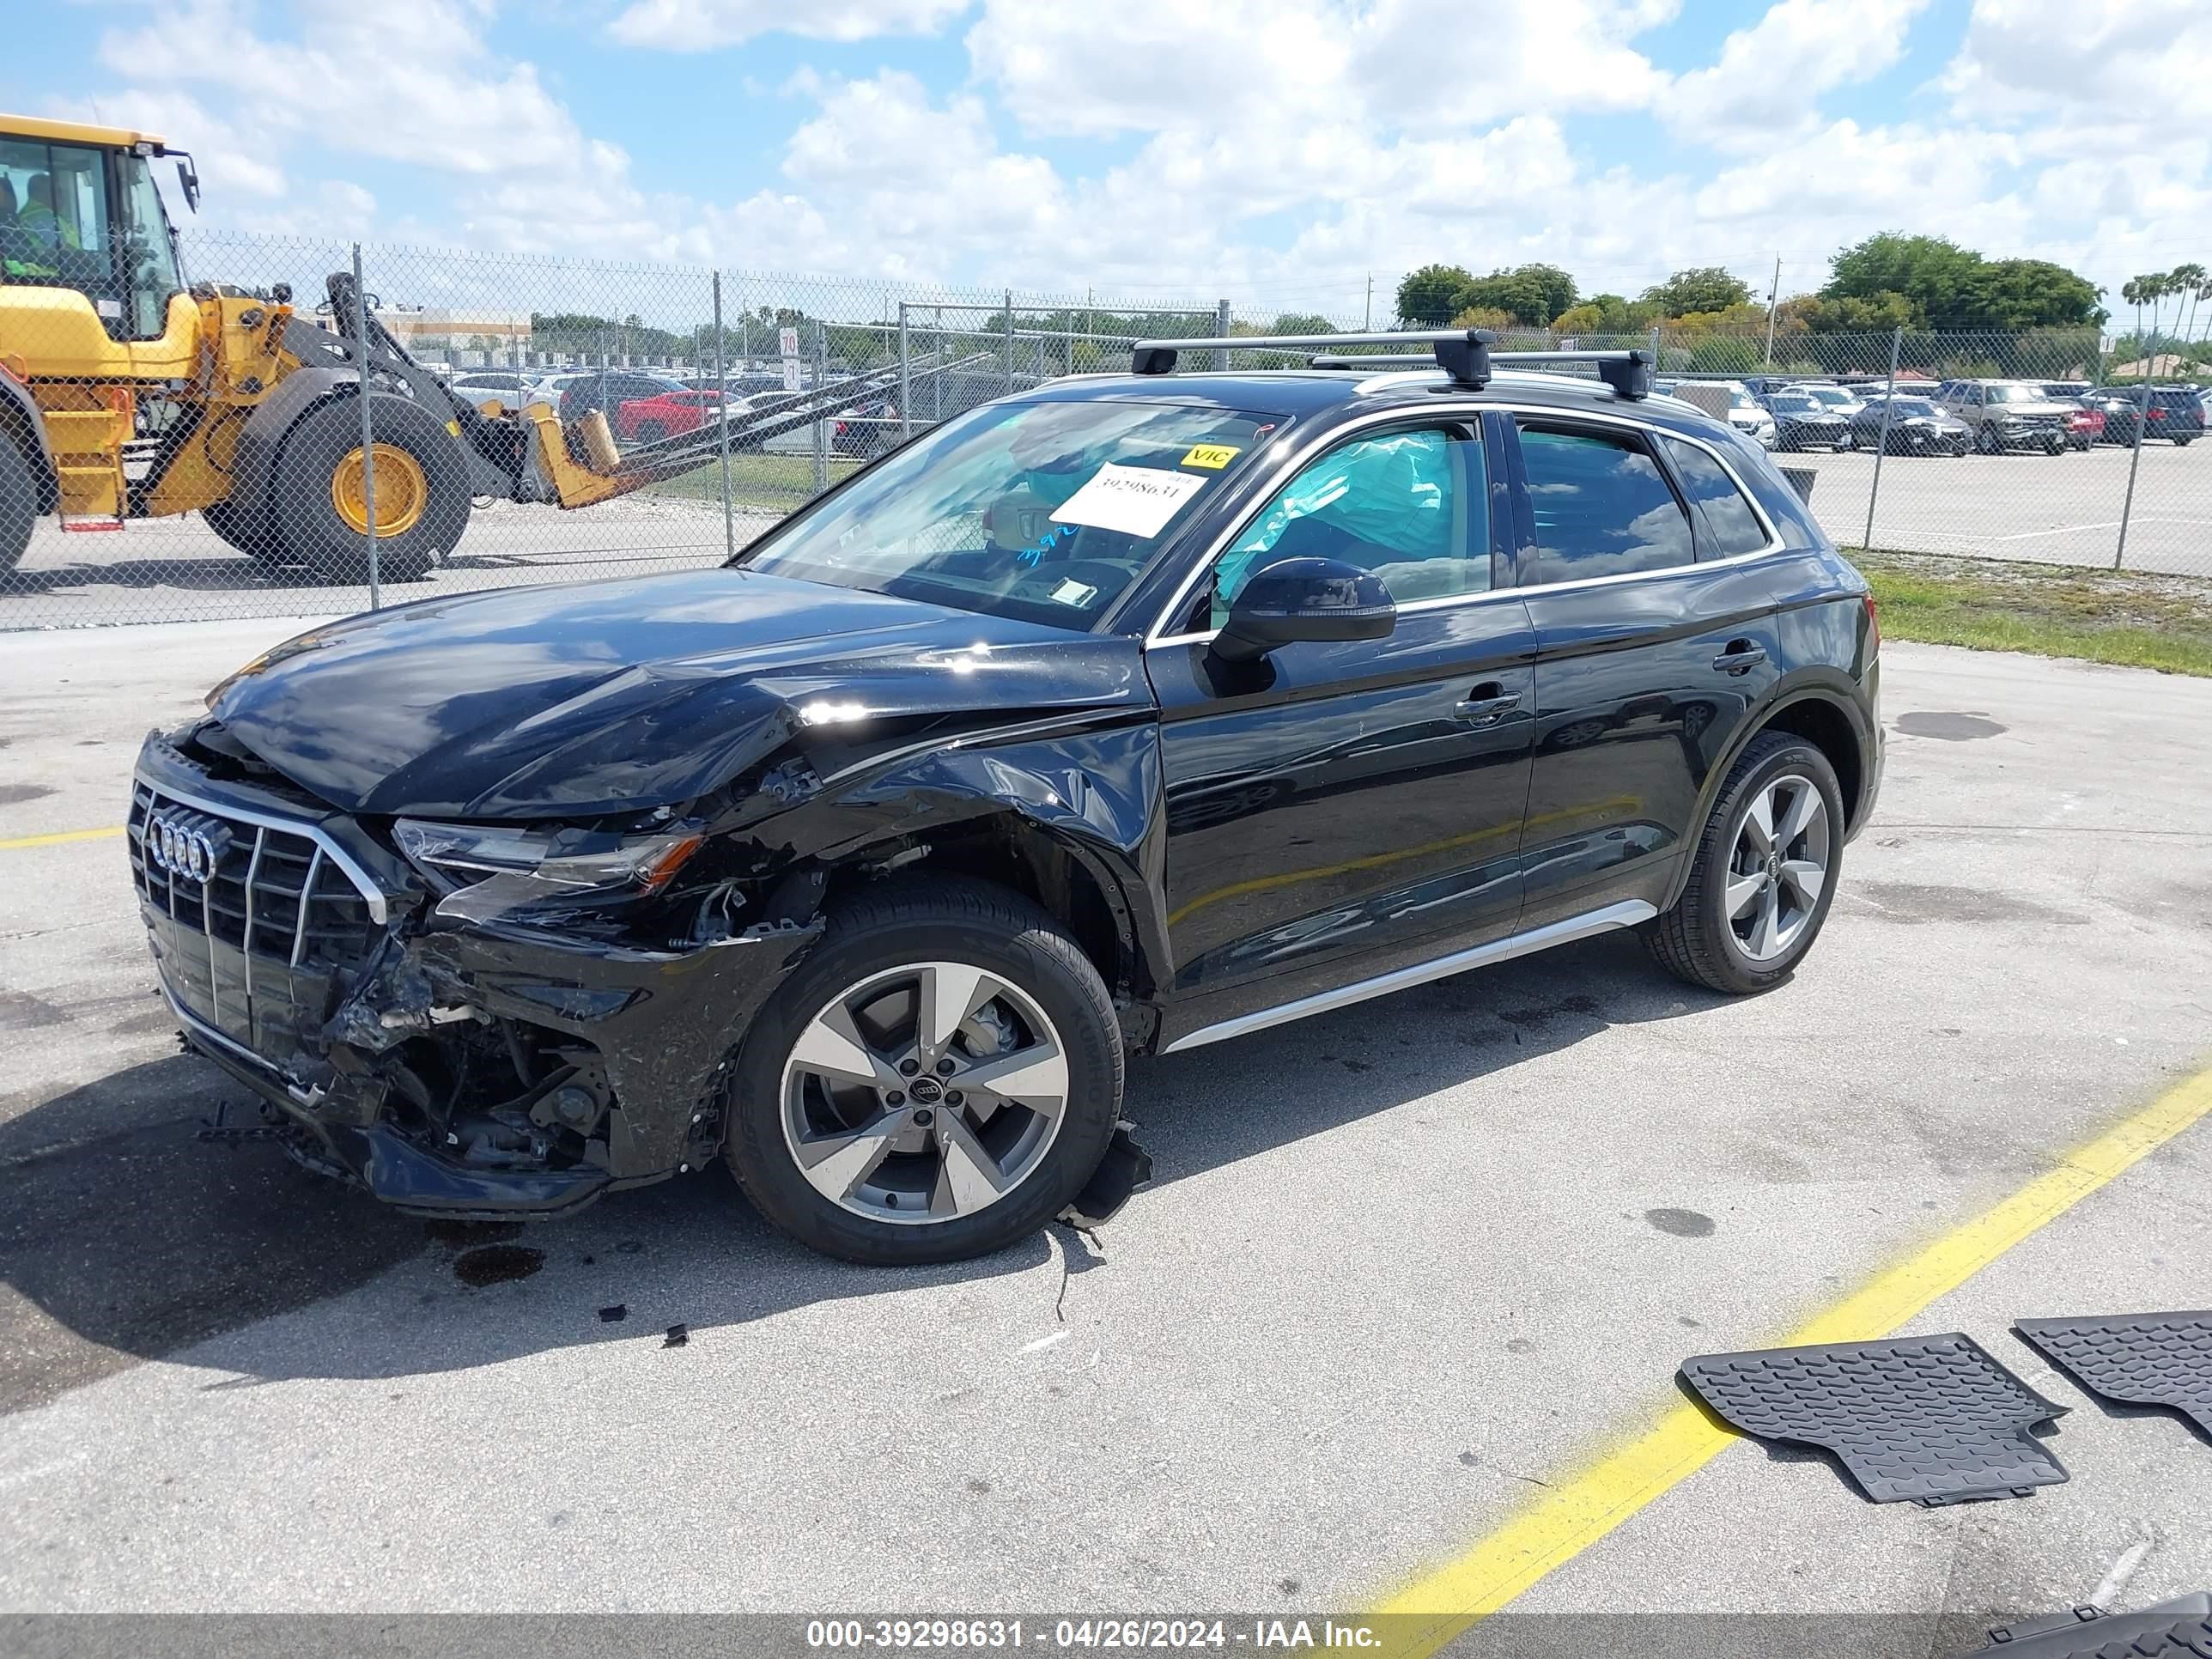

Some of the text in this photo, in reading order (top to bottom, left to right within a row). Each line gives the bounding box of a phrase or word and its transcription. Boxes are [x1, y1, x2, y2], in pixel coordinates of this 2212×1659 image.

[782, 336, 796, 353] 70
[1194, 449, 1230, 462] VIC
[1103, 478, 1180, 498] 39298631
